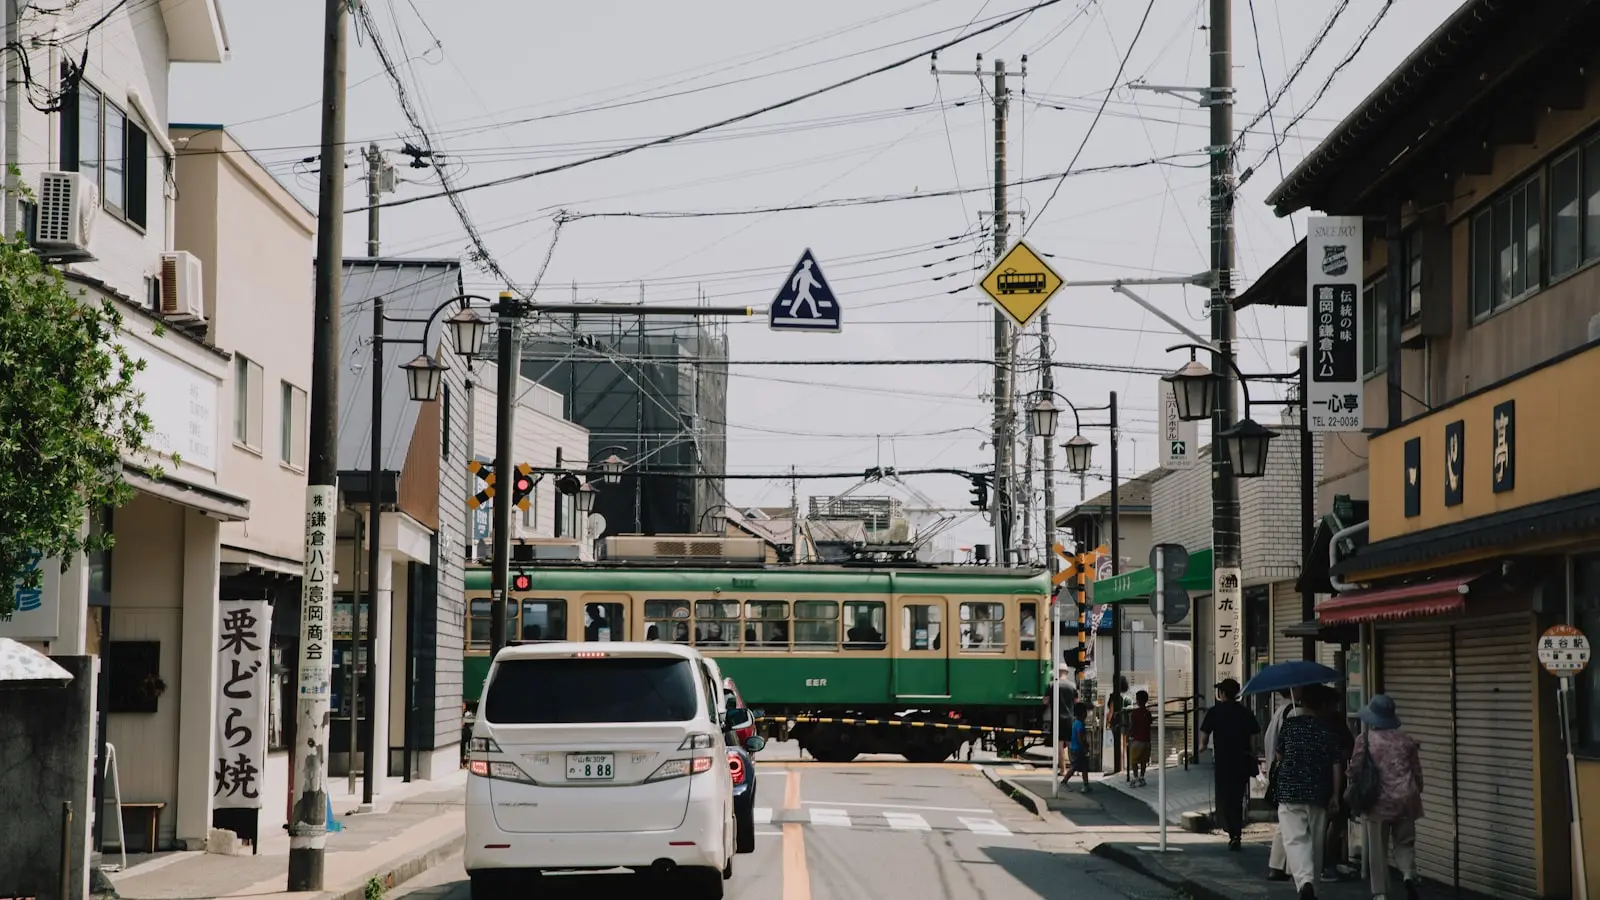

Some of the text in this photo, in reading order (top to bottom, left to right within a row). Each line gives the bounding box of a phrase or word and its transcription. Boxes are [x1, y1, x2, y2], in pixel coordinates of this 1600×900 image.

[1319, 287, 1334, 376] 富岡の鎌倉ハム
[1340, 290, 1352, 342] 伝統の味
[1312, 394, 1358, 413] 一心亭
[1312, 416, 1358, 427] TEL 22-0036
[1218, 598, 1234, 665] ホテル
[213, 608, 263, 799] 栗どら焼
[805, 678, 827, 686] EER
